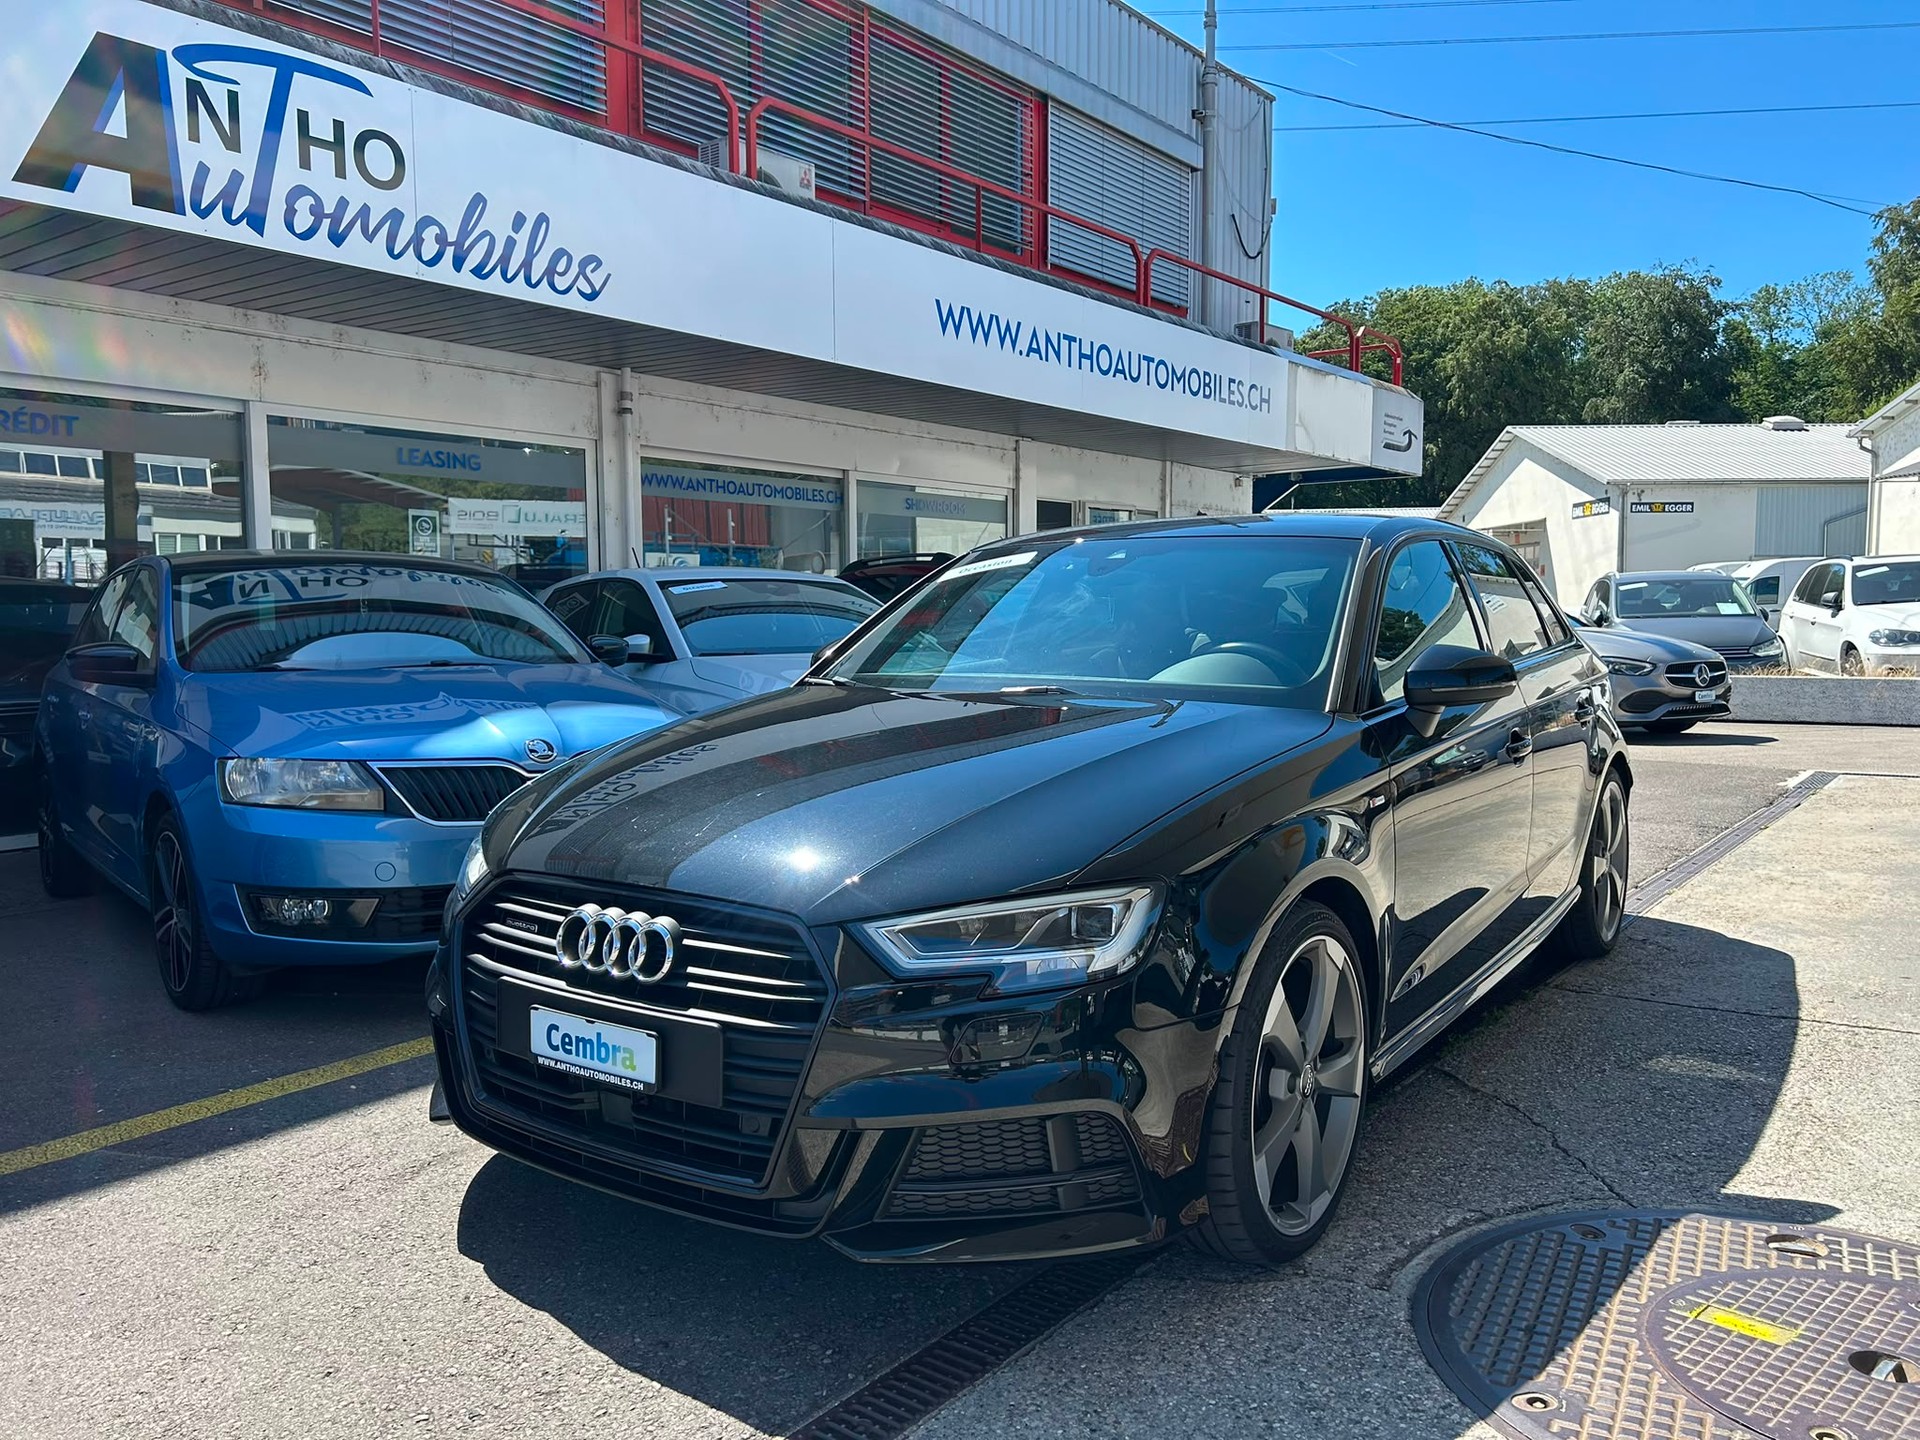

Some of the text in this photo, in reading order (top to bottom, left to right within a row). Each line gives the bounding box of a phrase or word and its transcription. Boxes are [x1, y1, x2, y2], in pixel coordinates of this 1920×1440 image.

[934, 298, 1271, 414] WWW.ANTHOAUTOMOBILES.CH
[397, 447, 481, 471] LEASING
[641, 473, 844, 504] WWW.ANTHOAUTOMOBILES.CH
[905, 498, 967, 515] SHOWROOM
[1631, 504, 1693, 512] EMIL EGGER
[546, 1023, 636, 1071] Cembra
[537, 1056, 644, 1091] WWW.ANTHOAUTOMOBILES.CH
